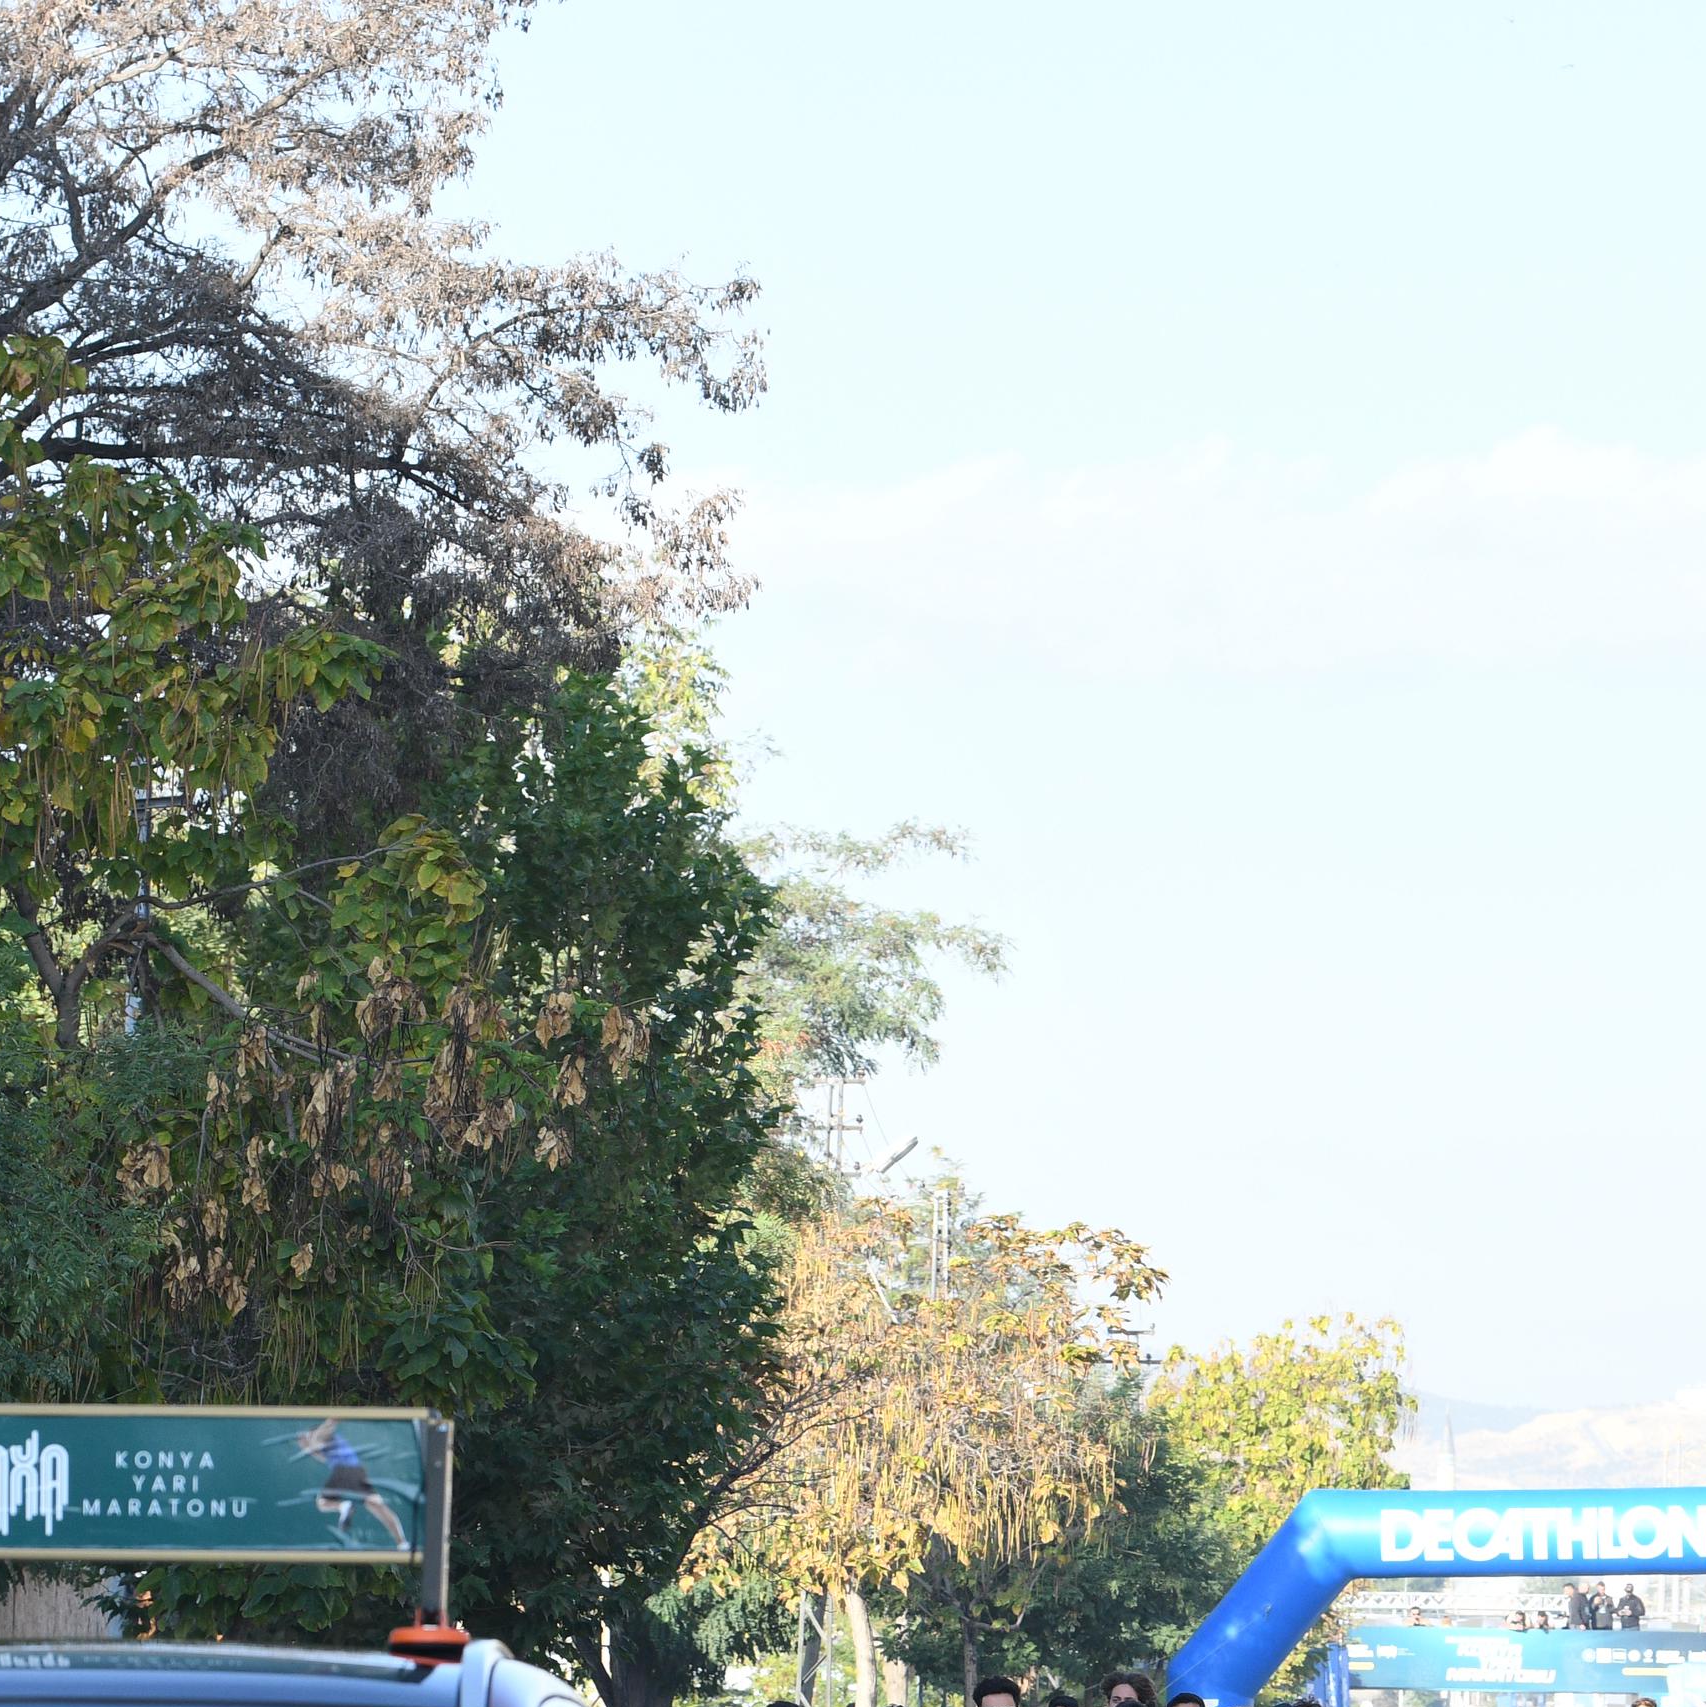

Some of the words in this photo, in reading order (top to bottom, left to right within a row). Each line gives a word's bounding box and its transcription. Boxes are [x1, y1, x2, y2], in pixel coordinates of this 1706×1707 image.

[115, 1450, 215, 1470] KONYA
[132, 1474, 200, 1493] YARI
[81, 1498, 249, 1518] MARATONU
